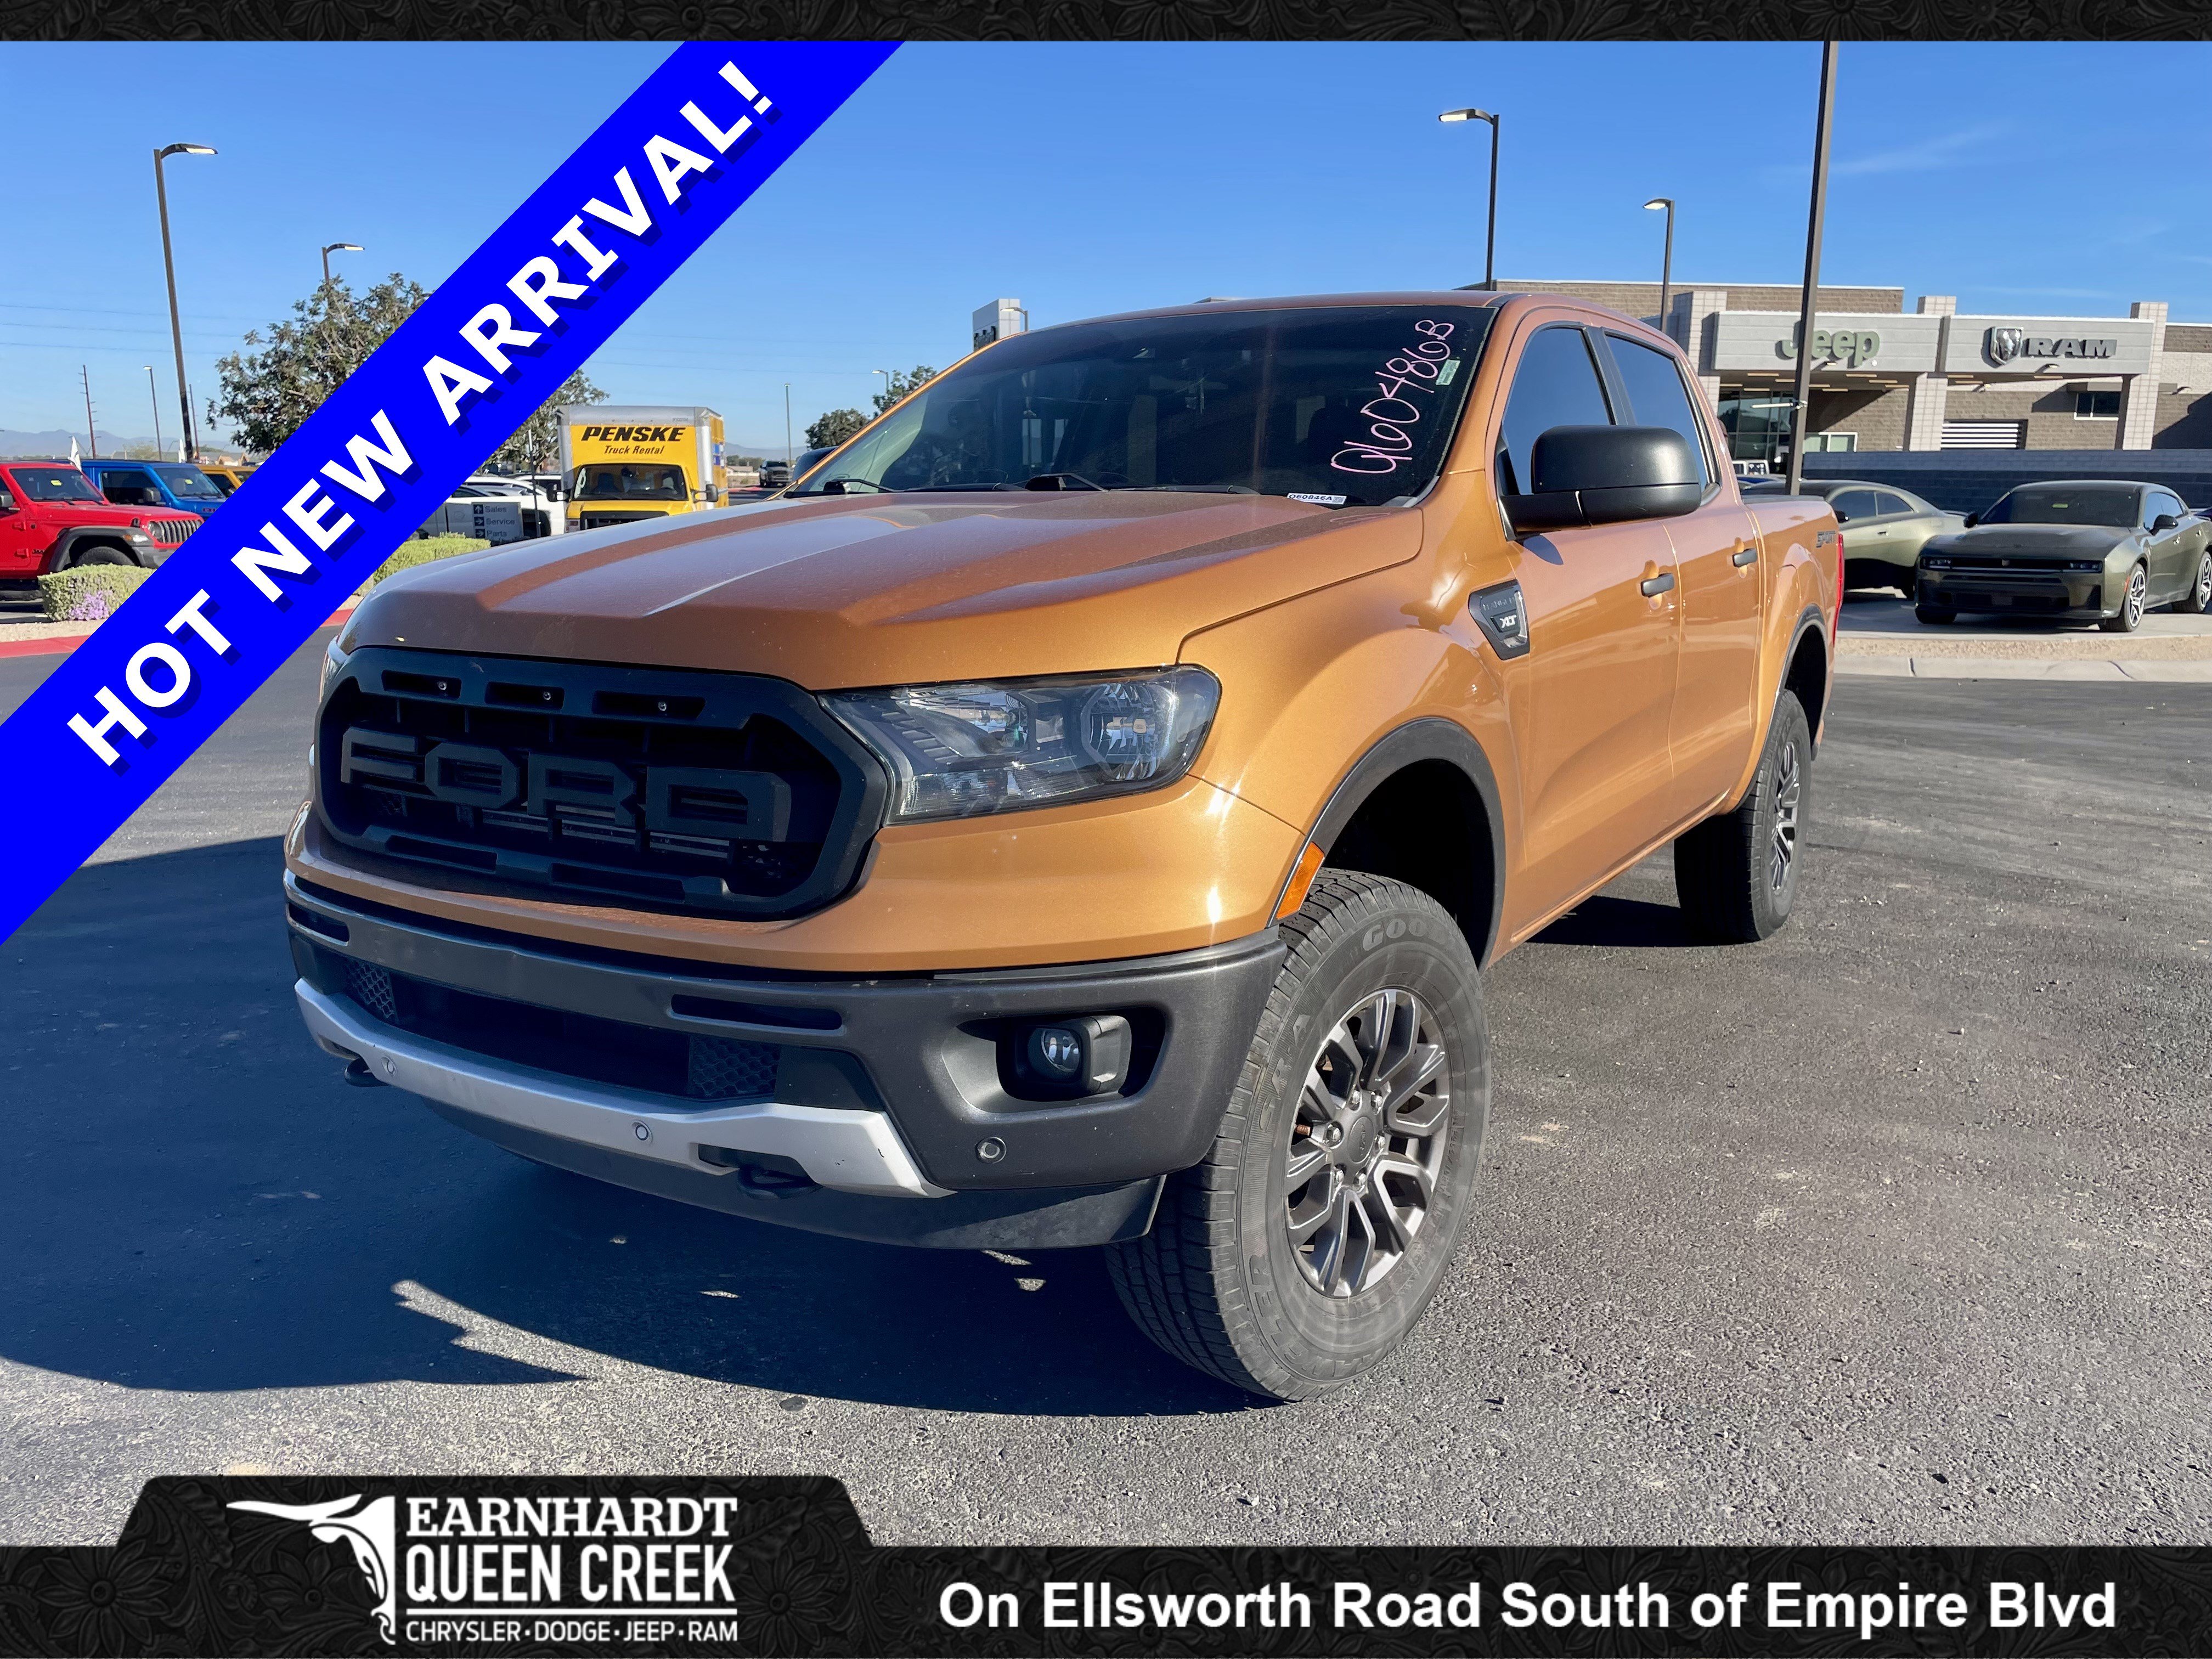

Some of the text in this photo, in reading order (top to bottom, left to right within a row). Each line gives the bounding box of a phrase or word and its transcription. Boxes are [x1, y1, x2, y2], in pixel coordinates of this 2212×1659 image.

[2027, 338, 2117, 357] RAM
[581, 426, 686, 442] PENSKE
[604, 445, 665, 455] Truck Rental
[1499, 614, 1517, 628] XLT
[341, 726, 791, 843] FORD
